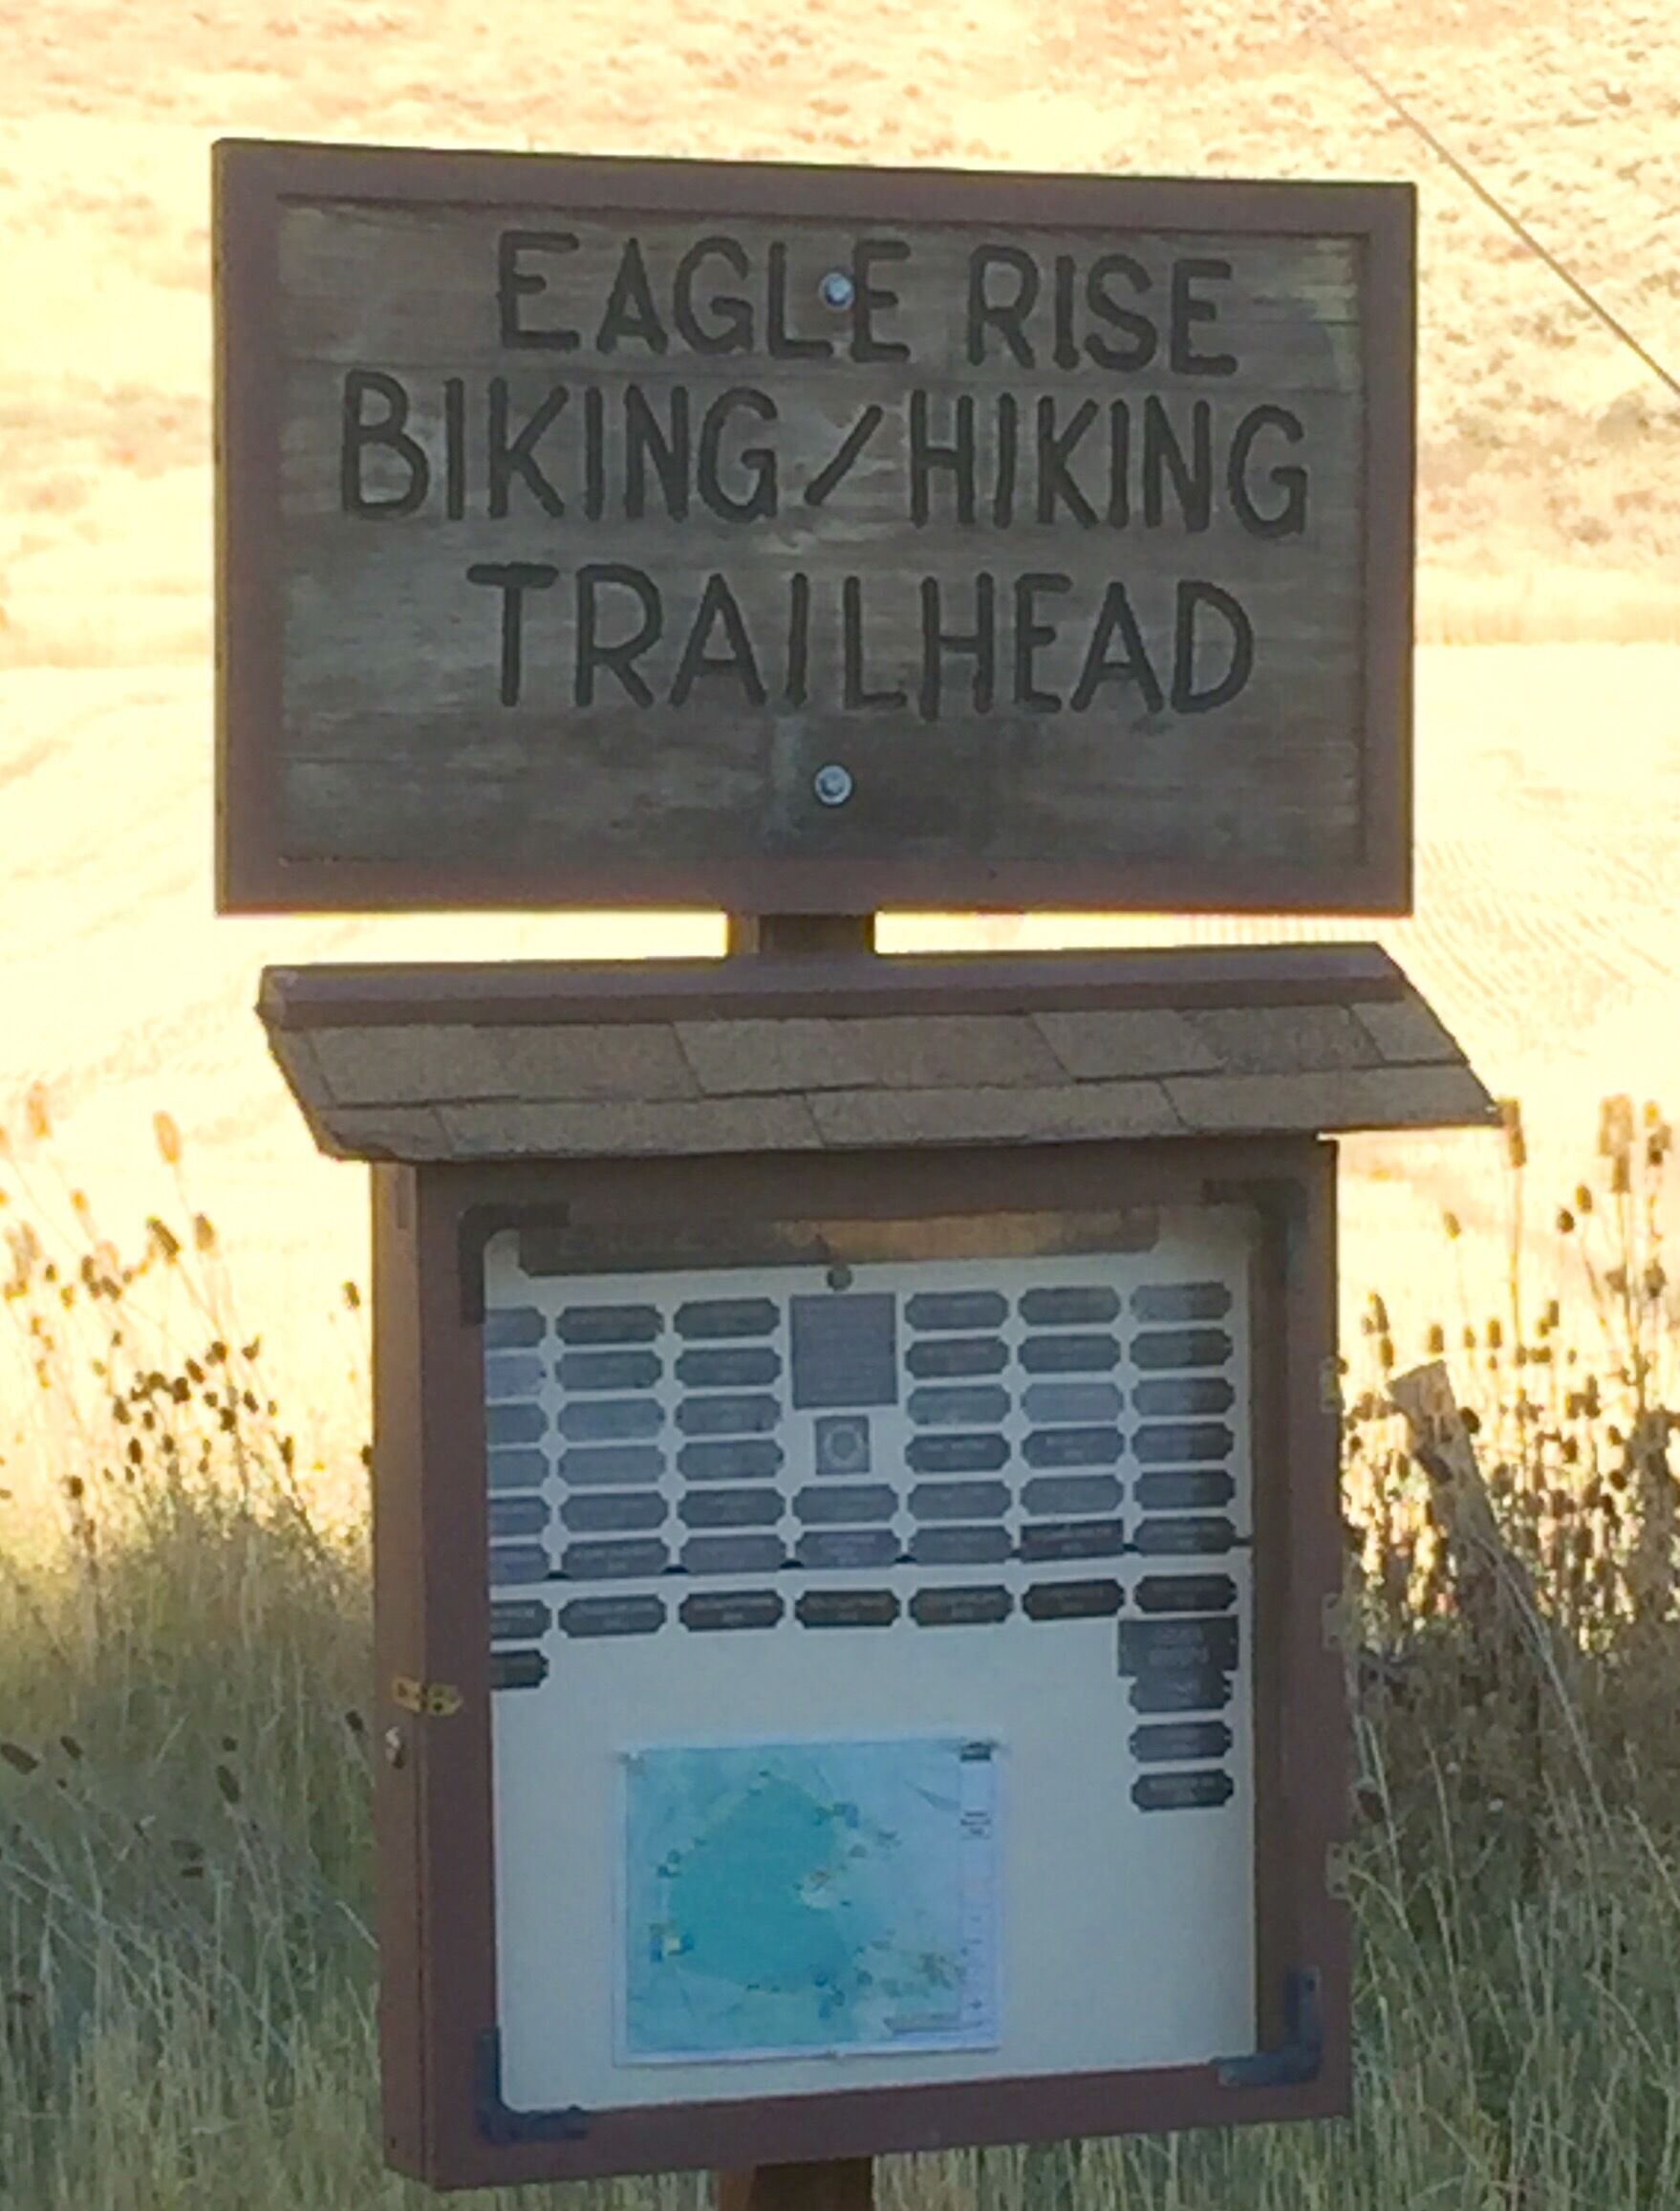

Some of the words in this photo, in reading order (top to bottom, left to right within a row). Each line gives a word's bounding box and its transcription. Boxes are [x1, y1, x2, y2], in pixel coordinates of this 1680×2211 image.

[497, 229, 914, 364] EAGLE
[966, 243, 1239, 375] RISE
[465, 561, 1255, 721] TRAILHEAD
